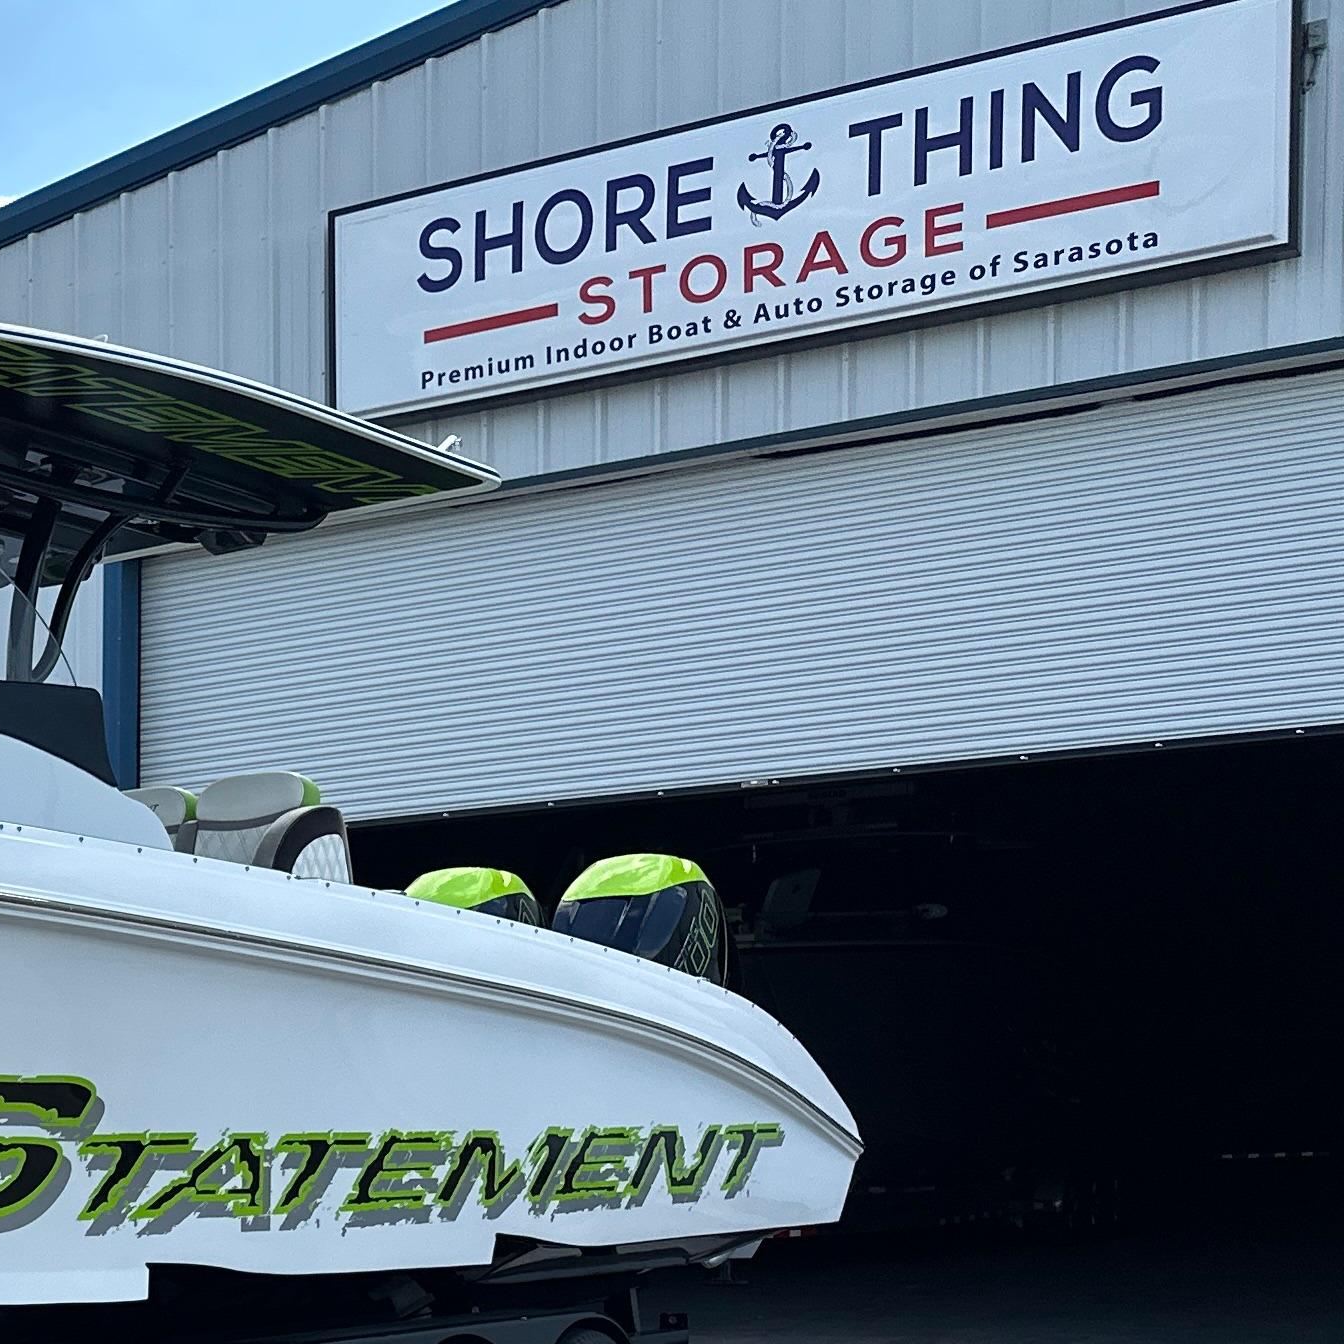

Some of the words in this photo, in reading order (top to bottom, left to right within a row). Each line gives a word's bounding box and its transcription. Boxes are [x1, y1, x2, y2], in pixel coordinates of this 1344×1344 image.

[416, 156, 714, 294] SHORE
[848, 55, 1163, 197] THING
[421, 353, 535, 390] Premium
[546, 332, 637, 365] Indoor
[648, 315, 712, 345] Boat
[723, 309, 742, 329] &
[753, 295, 823, 324] Auto
[835, 269, 956, 308] Storage
[969, 254, 1001, 280] of
[1013, 231, 1159, 273] Sarasota
[578, 202, 964, 325] STORAGE
